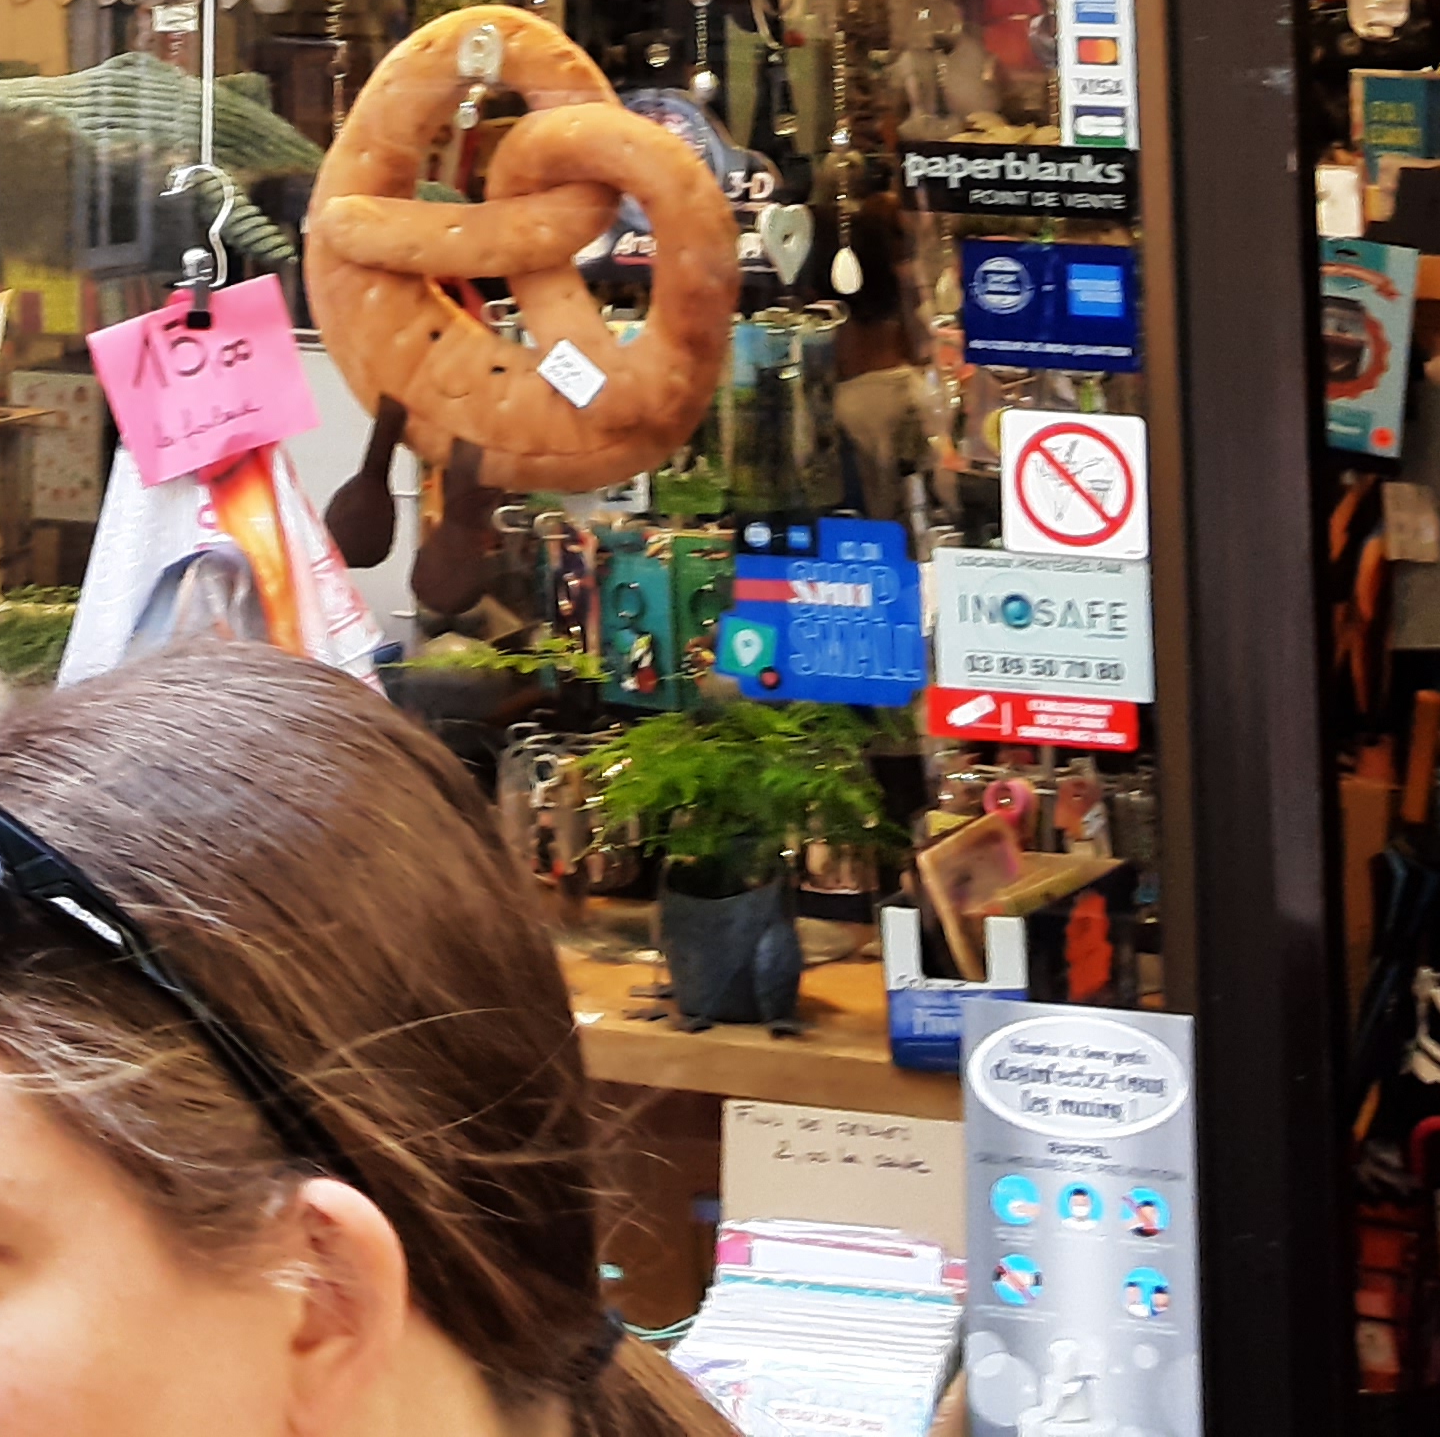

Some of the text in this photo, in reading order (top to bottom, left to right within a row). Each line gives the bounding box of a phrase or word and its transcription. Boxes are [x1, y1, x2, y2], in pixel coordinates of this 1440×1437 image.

[901, 151, 1126, 188] paperblanks
[968, 188, 1127, 211] POINT DE VENTE
[957, 591, 1129, 633] INOSAFE
[788, 616, 922, 681] SMALL
